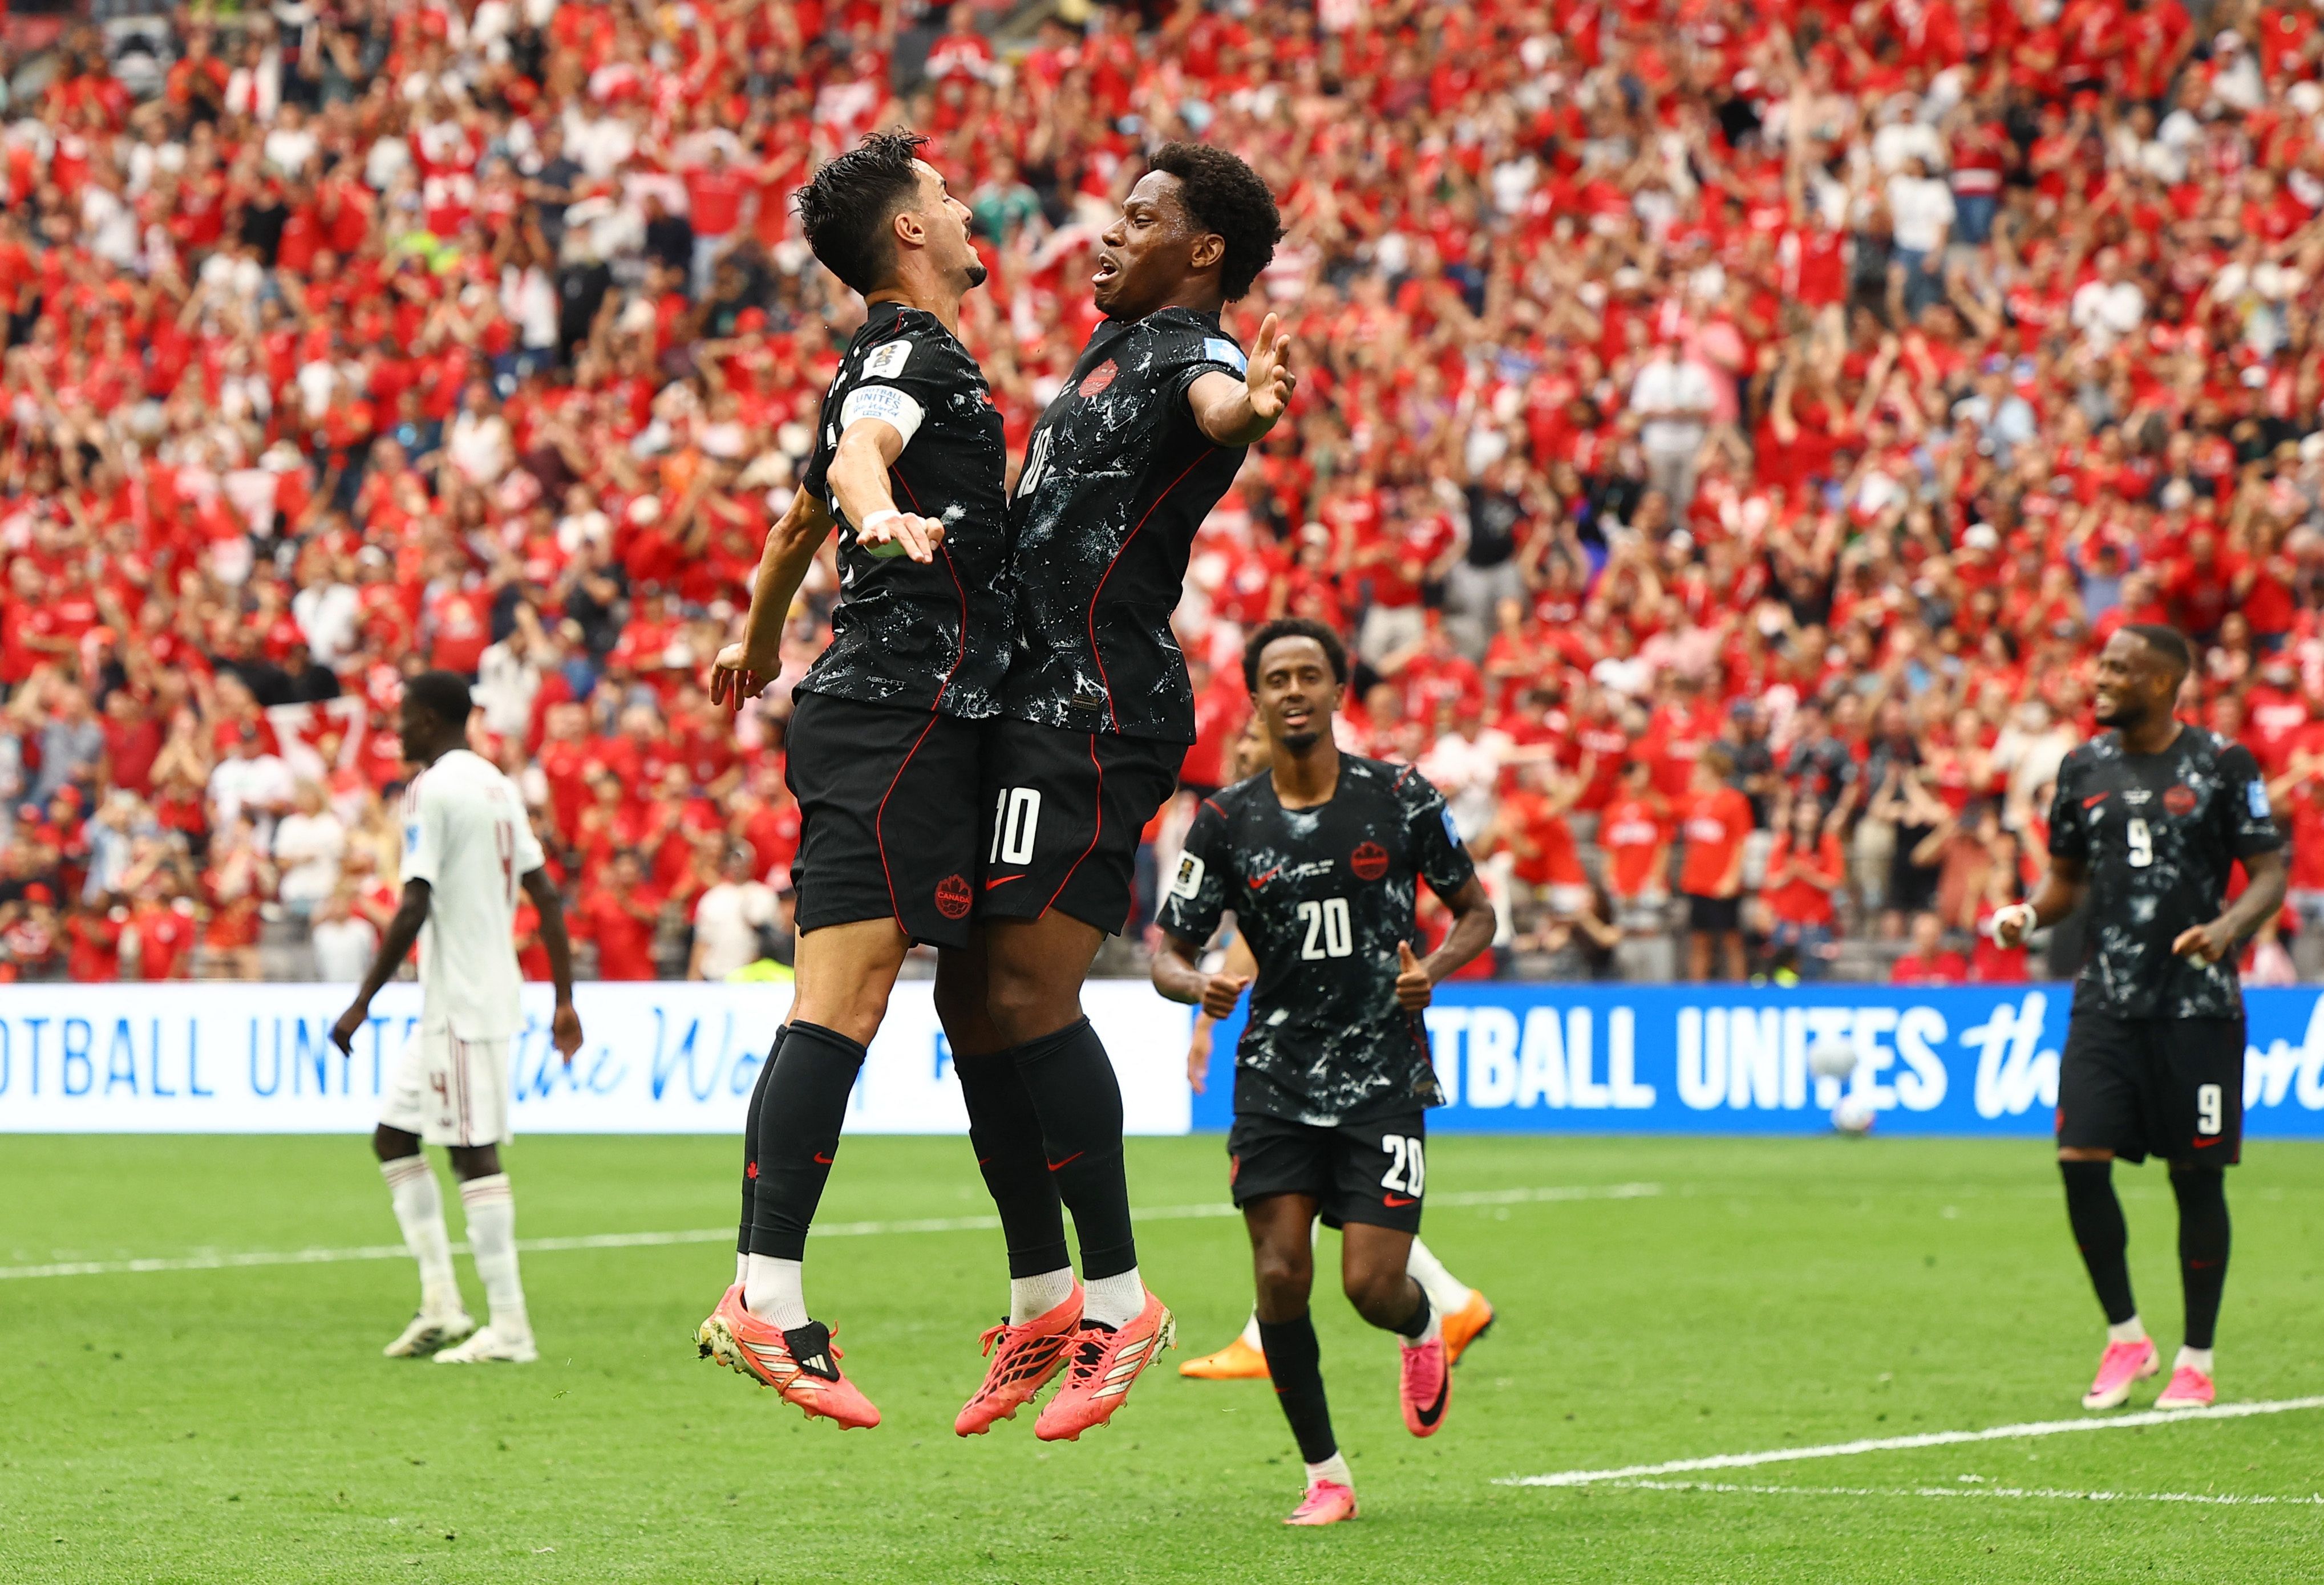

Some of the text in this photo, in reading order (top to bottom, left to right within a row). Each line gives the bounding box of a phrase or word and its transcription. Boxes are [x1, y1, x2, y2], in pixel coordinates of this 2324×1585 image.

[856, 394, 901, 409] UNITES
[1017, 424, 1053, 498] 10
[865, 675, 906, 687] AERO-FIT
[990, 787, 1041, 865] 10
[2126, 818, 2153, 868] 9
[495, 820, 515, 906] 4
[937, 891, 970, 903] CANADA
[1297, 897, 1353, 961] 20
[250, 1017, 419, 1096] UNIT
[650, 1007, 768, 1102] Wo
[1423, 1006, 1657, 1109] TBALL
[1677, 1006, 1949, 1112] UNITES
[1959, 990, 2060, 1119] th
[429, 1071, 448, 1108] 4
[2197, 1083, 2222, 1135] 9
[1380, 1134, 1425, 1198] 20
